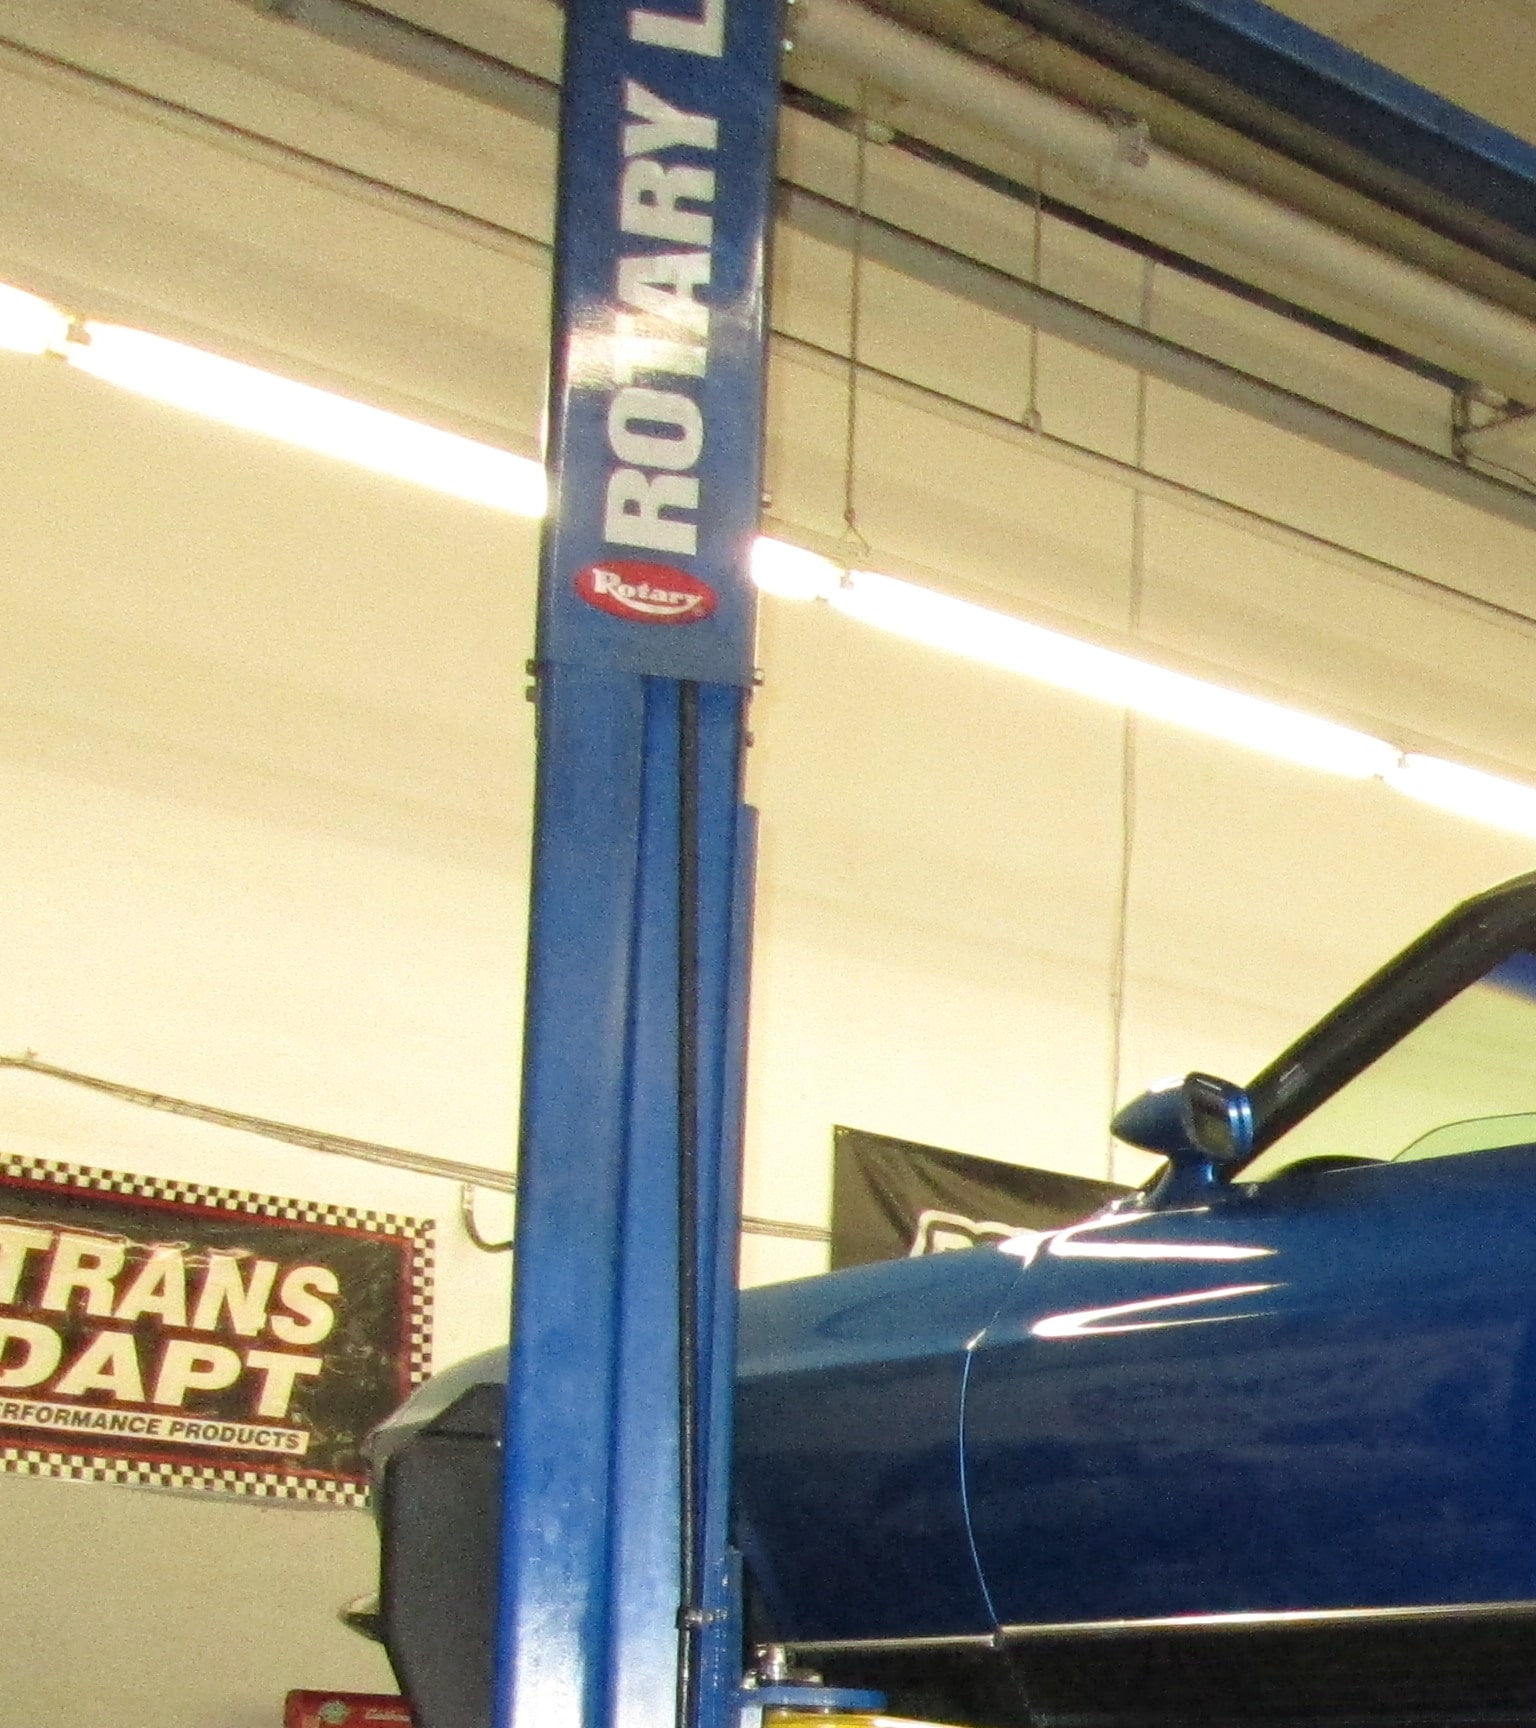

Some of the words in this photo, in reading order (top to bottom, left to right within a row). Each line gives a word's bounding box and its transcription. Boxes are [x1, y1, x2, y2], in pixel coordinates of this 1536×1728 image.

[604, 77, 719, 556] ROTARY
[592, 567, 704, 611] Rotary
[0, 1224, 340, 1346] TRANS
[0, 1317, 324, 1419] DAPT
[0, 1401, 160, 1437] RFORMANCE
[169, 1420, 301, 1450] PRODUCTS
